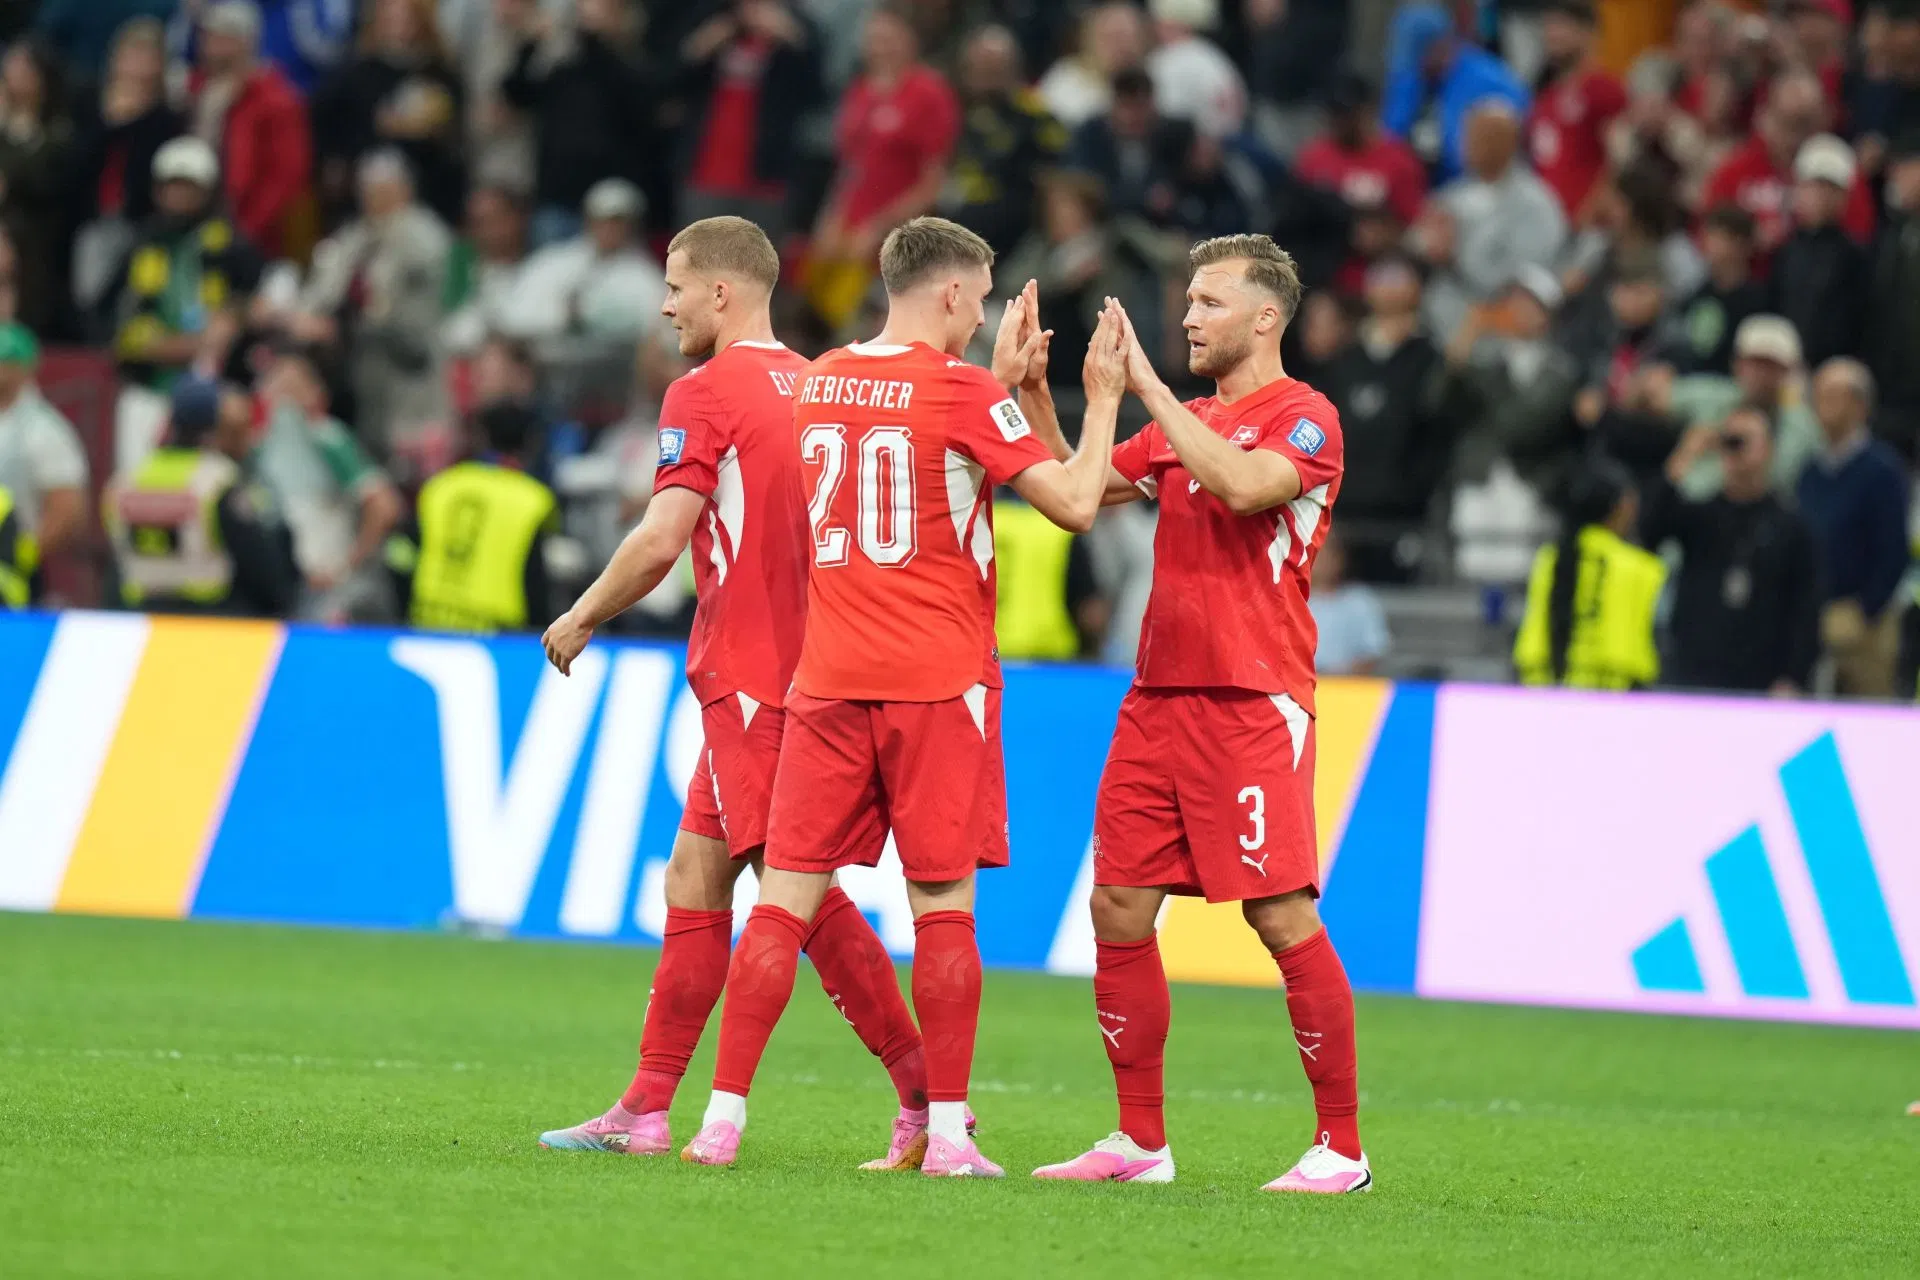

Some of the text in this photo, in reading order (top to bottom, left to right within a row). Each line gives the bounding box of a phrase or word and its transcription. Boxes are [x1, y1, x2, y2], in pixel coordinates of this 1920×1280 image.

[800, 375, 914, 409] AEBISCHER
[800, 423, 918, 569] 20
[1238, 785, 1265, 851] 3
